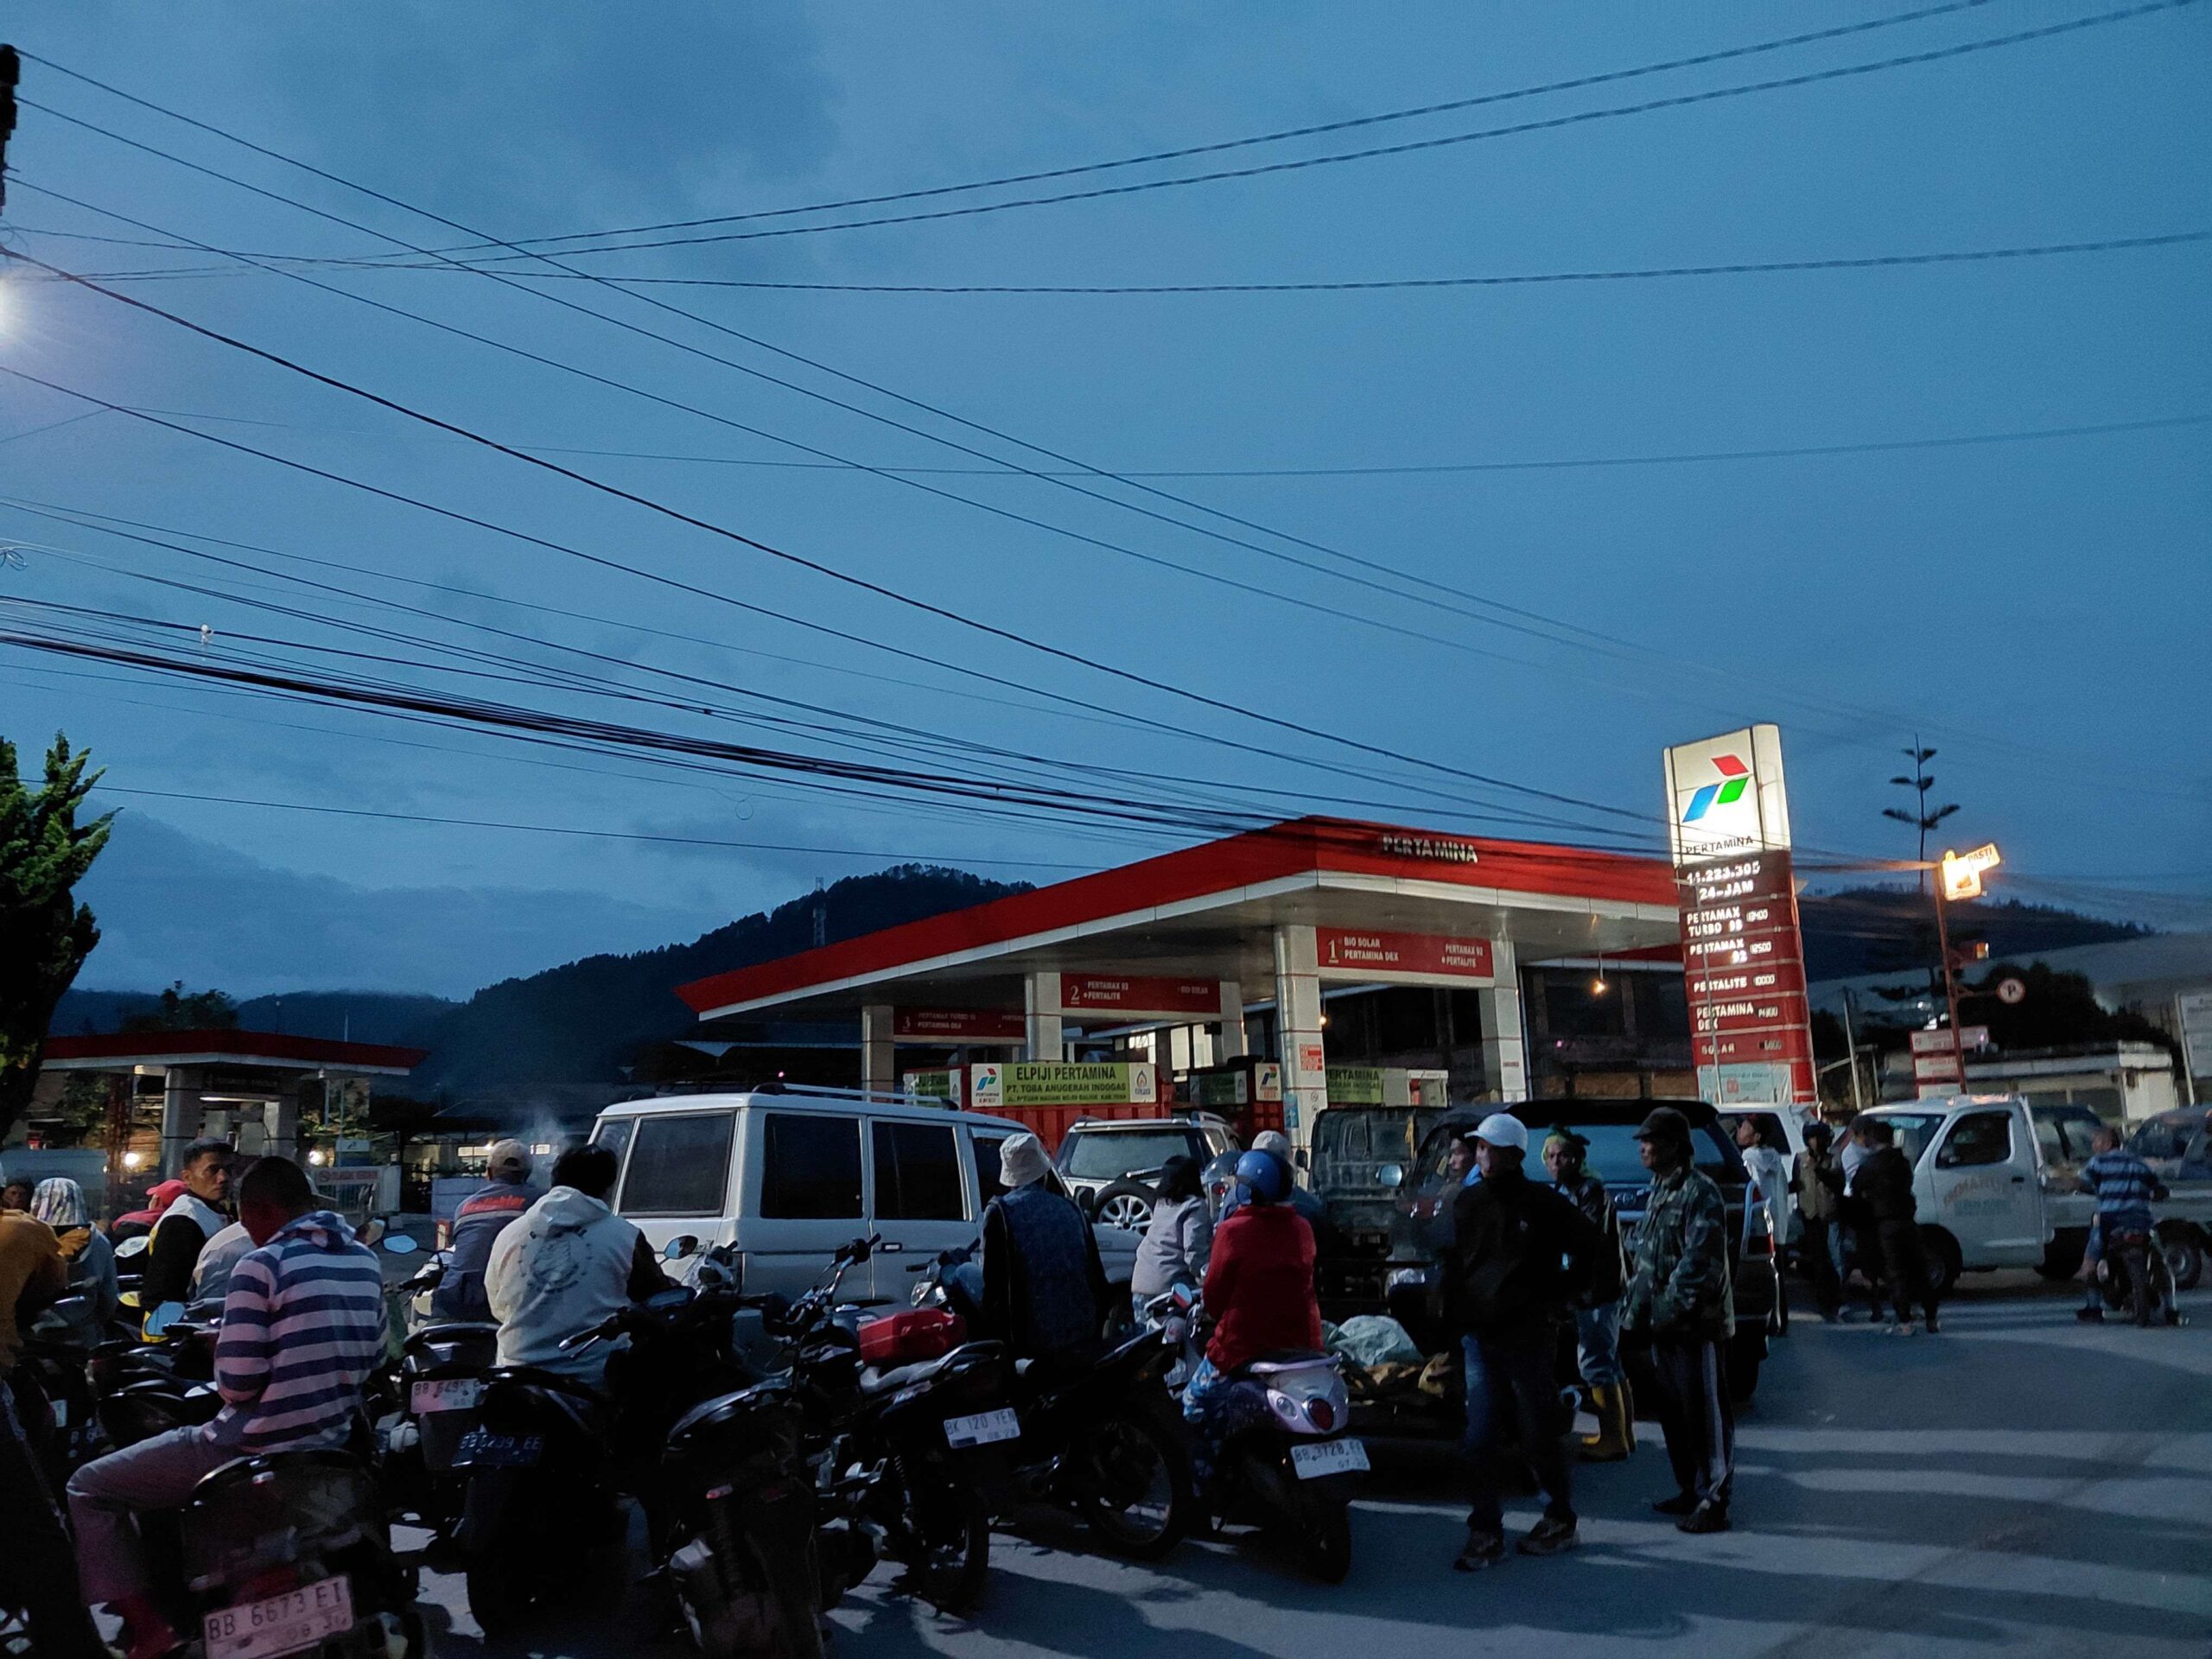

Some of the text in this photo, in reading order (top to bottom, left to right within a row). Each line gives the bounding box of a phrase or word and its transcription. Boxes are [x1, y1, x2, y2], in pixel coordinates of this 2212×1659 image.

[1383, 836, 1478, 864] PERTAMINA
[1686, 836, 1753, 855] PERTAMINA
[1688, 923, 1721, 937] TURBO
[1344, 937, 1357, 947] BIO
[1344, 949, 1399, 963] PERTAMINA DEX
[1070, 985, 1080, 1001] 2
[1017, 1066, 1116, 1081] ELPIJI PERTAMINA
[1007, 1084, 1019, 1094] PT.
[1021, 1084, 1042, 1093] TOBA
[208, 1614, 236, 1640] BB
[251, 1592, 305, 1626] 6673
